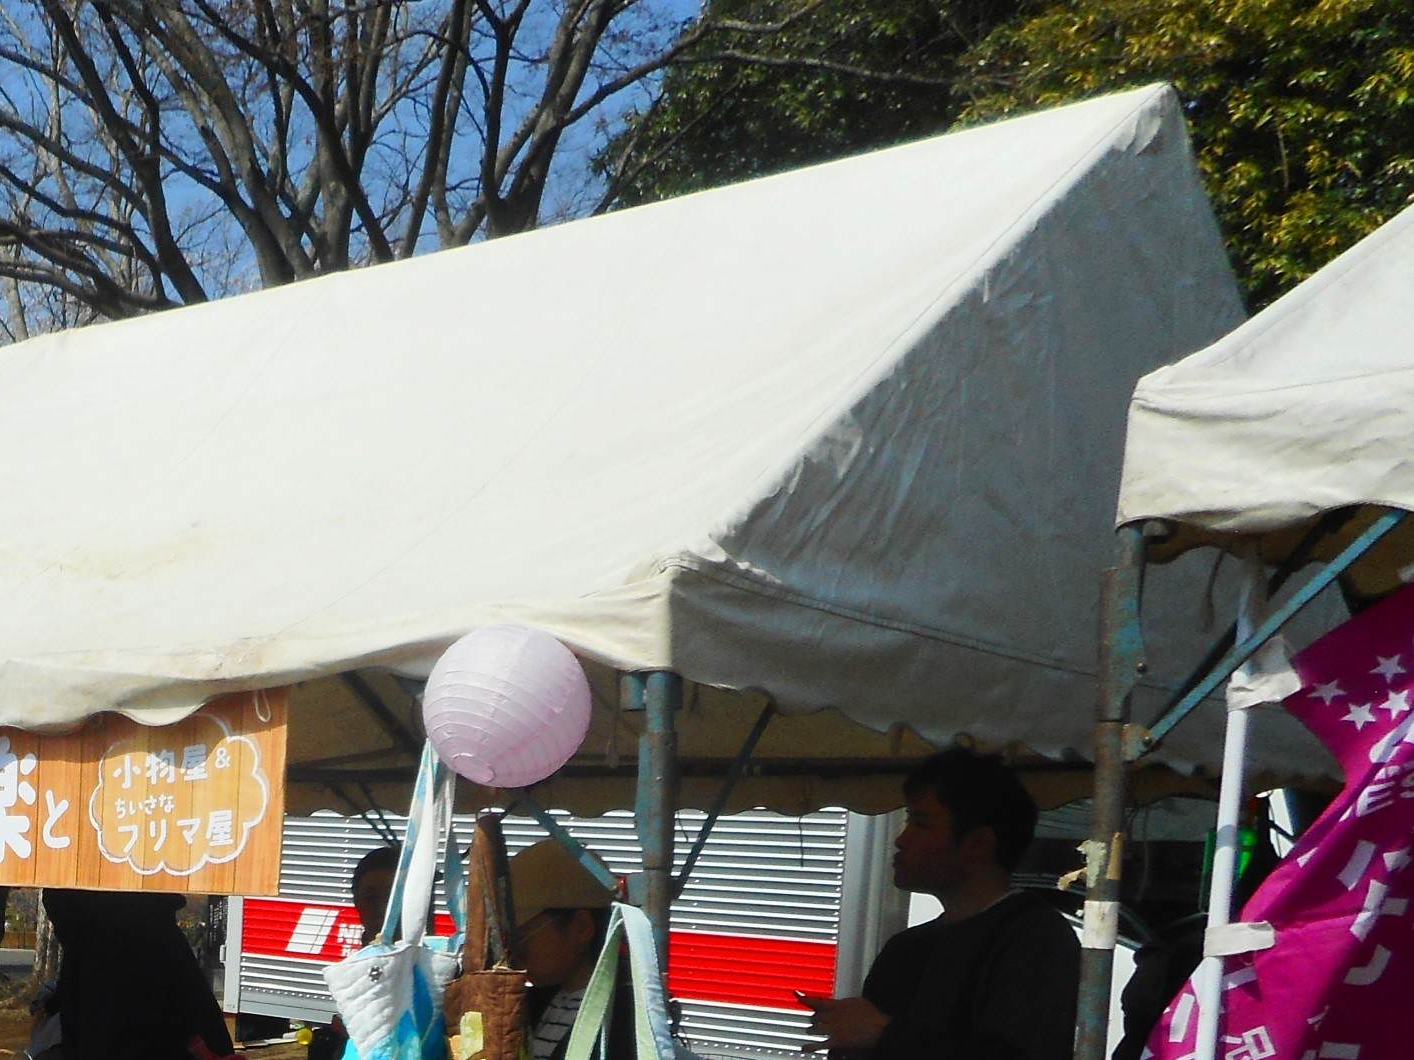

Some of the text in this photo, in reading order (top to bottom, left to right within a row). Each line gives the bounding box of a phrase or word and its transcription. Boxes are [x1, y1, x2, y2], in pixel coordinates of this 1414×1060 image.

[115, 794, 174, 818] ちいさな
[118, 810, 234, 852] フリマ屋
